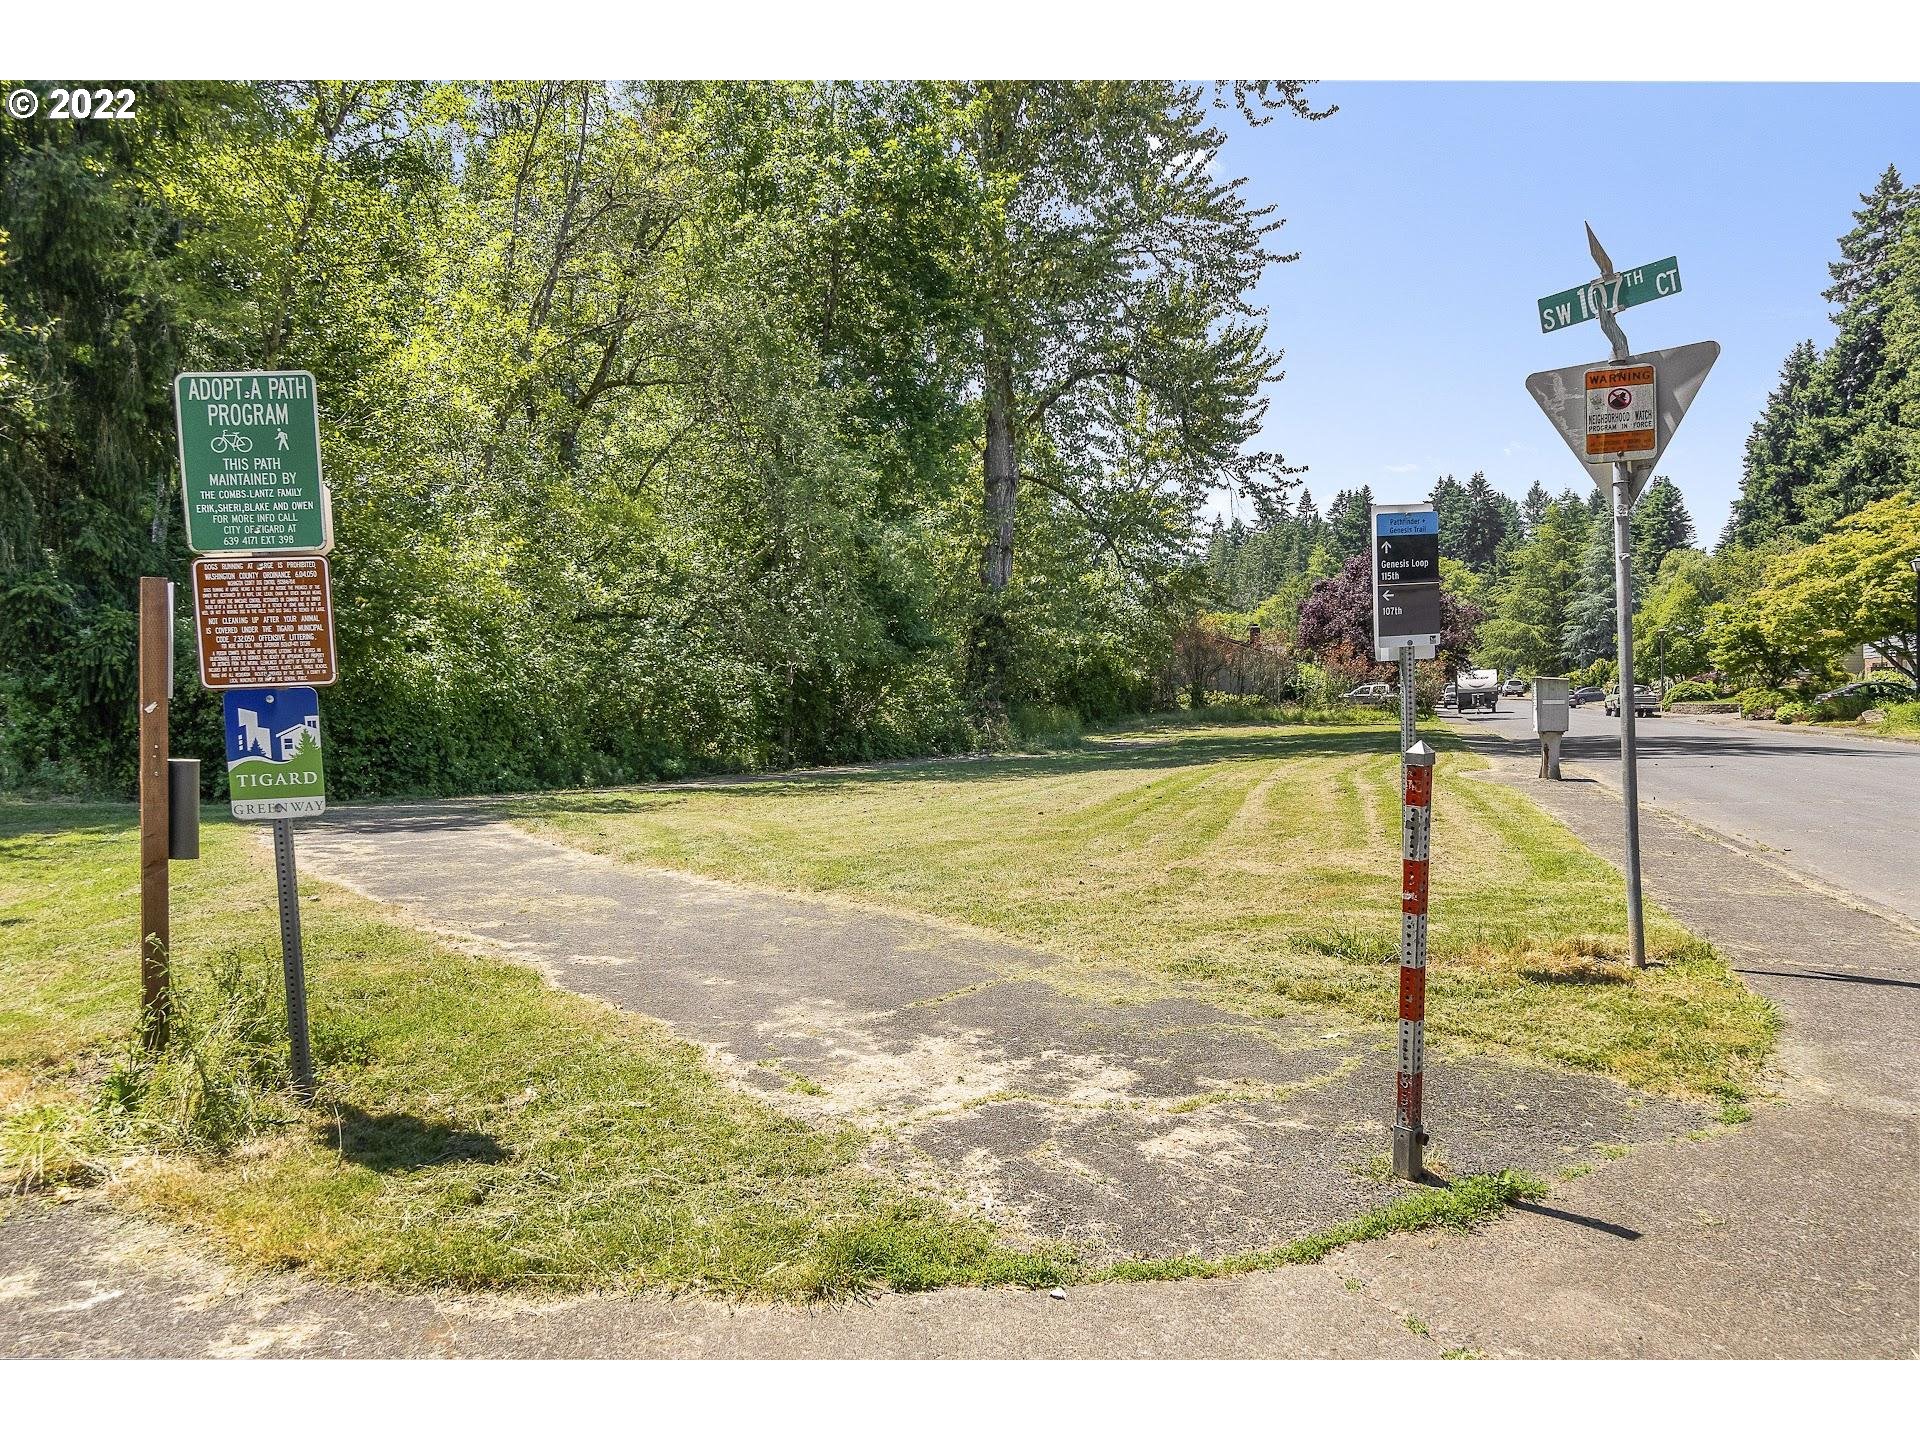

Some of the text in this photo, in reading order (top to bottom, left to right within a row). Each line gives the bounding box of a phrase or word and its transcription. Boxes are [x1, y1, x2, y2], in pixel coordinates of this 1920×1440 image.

[1543, 269, 1678, 330] SW 107 TH CT
[1590, 372, 1650, 384] WARNING
[268, 377, 307, 399] PATH
[208, 403, 289, 426] PROGRAM
[1588, 410, 1652, 425] NEIGHBORHOOD WATCH
[1588, 423, 1617, 432] PROGRAM
[223, 458, 281, 470] THIS PATH
[210, 473, 297, 486] MAINTAINED BY
[200, 491, 216, 499] THE
[278, 488, 302, 497] FAMILY
[273, 502, 288, 510] AND
[213, 513, 298, 523] FOR MORE INFO CALL
[224, 526, 240, 534] CITY
[288, 524, 297, 532] AT
[224, 535, 294, 545] 639 4171 EXT 398
[222, 562, 244, 570] RUNNING
[256, 562, 274, 570] ARGE
[1381, 559, 1429, 569] Genesis Loop
[205, 572, 235, 580] WASHINGTON
[1381, 572, 1400, 581] 115th
[1383, 607, 1402, 615] 107th
[215, 626, 238, 634] COVERED
[298, 624, 324, 632] MUNICIPAL
[237, 772, 317, 787] TIGARD
